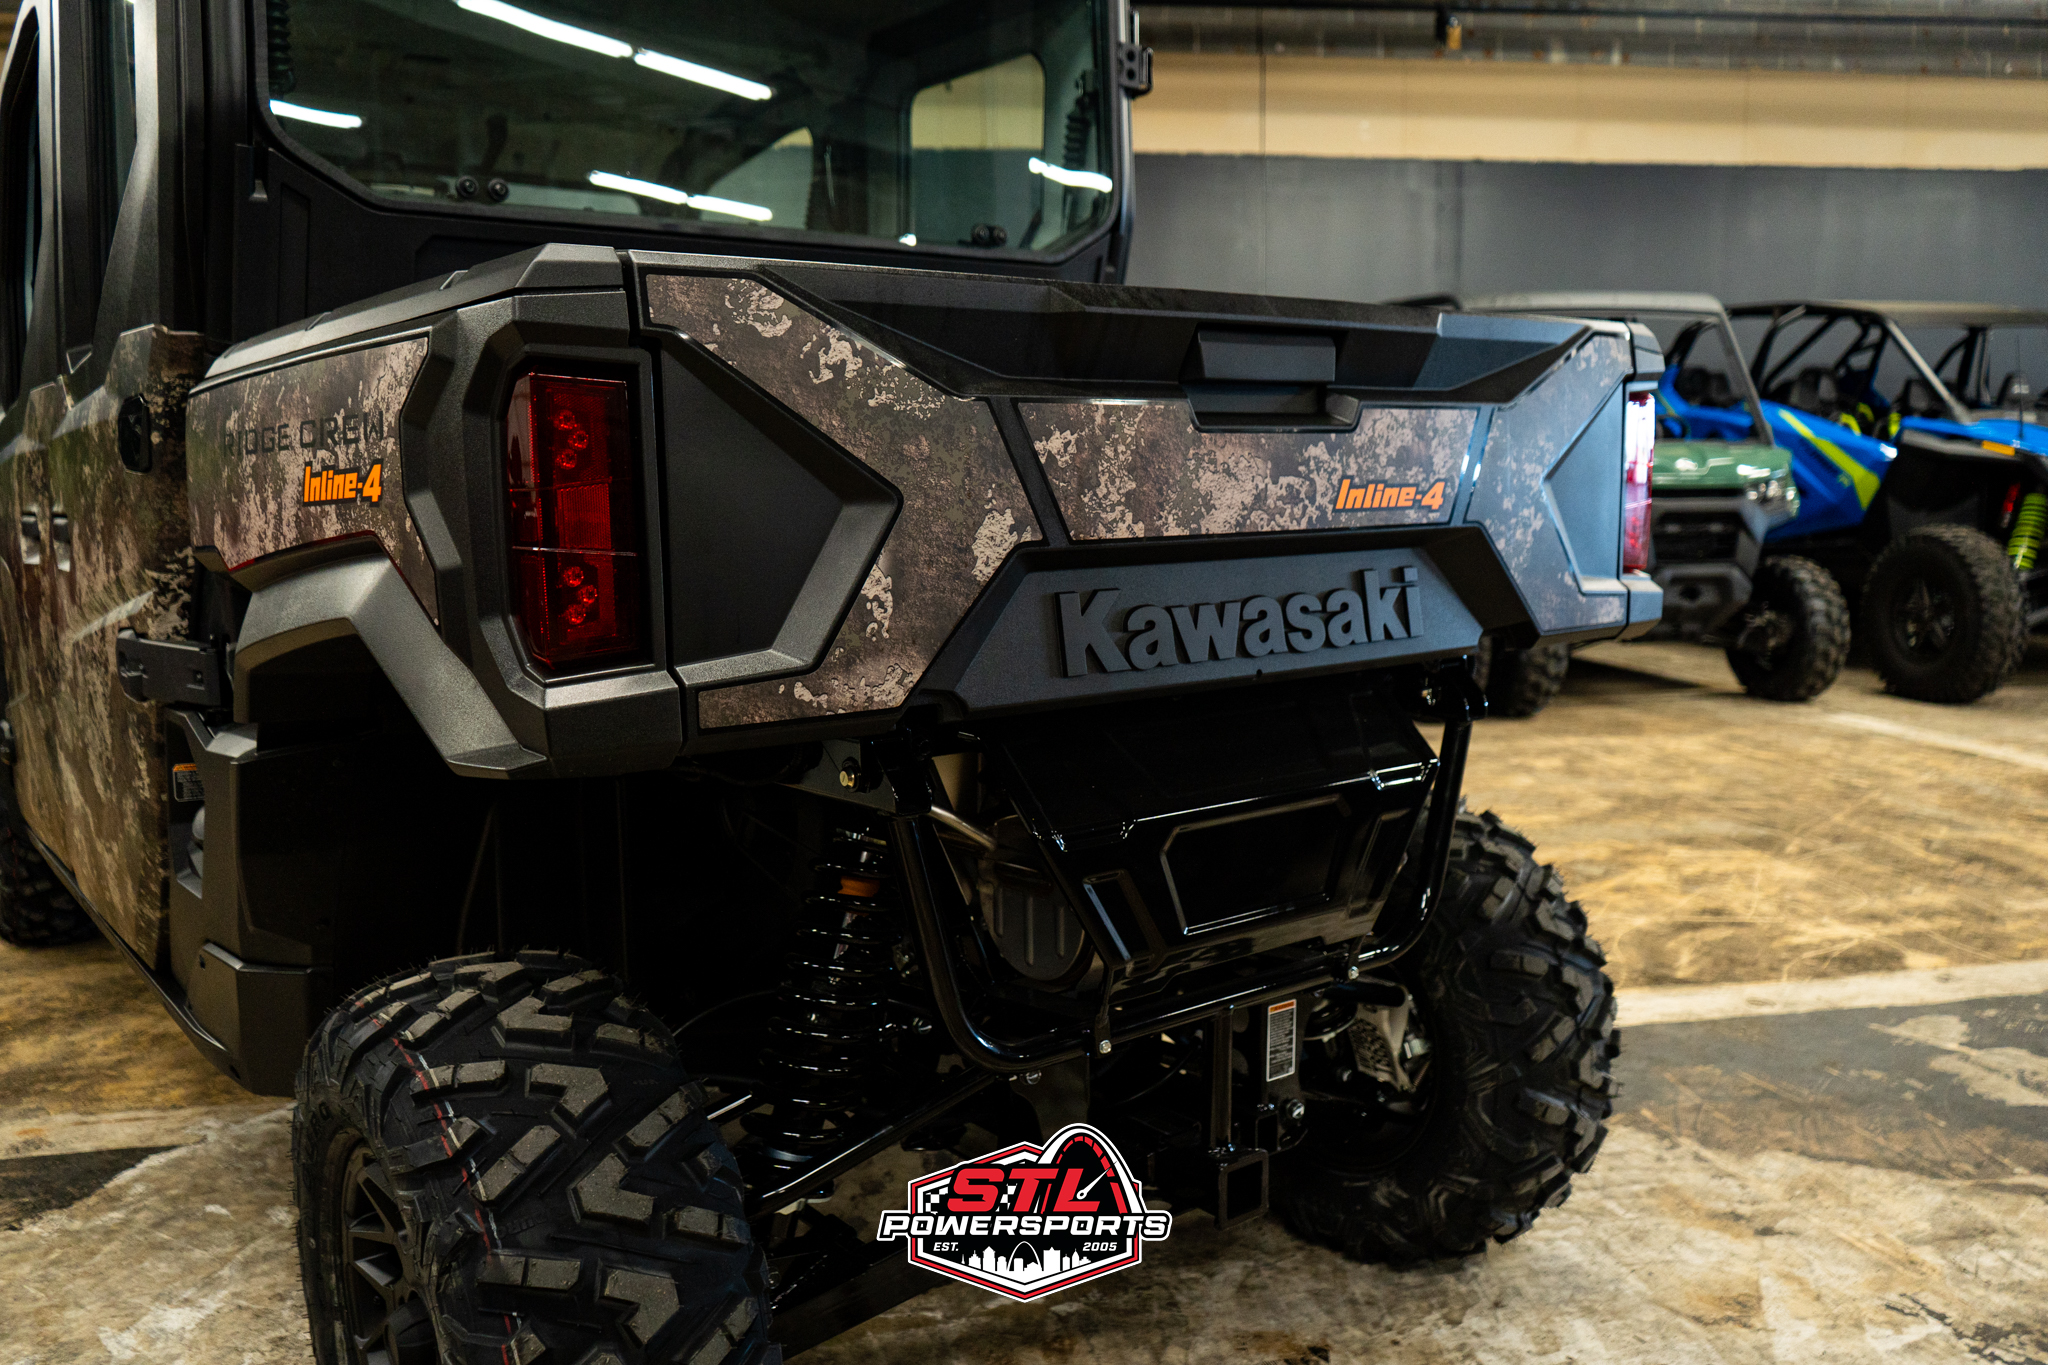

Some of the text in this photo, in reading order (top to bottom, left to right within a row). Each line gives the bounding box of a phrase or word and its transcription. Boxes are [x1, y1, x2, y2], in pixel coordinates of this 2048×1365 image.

[223, 410, 384, 458] RIDGE CREW
[303, 460, 383, 504] Inline-4
[1334, 478, 1445, 511] Inline-4
[1054, 565, 1425, 678] Kawasaki
